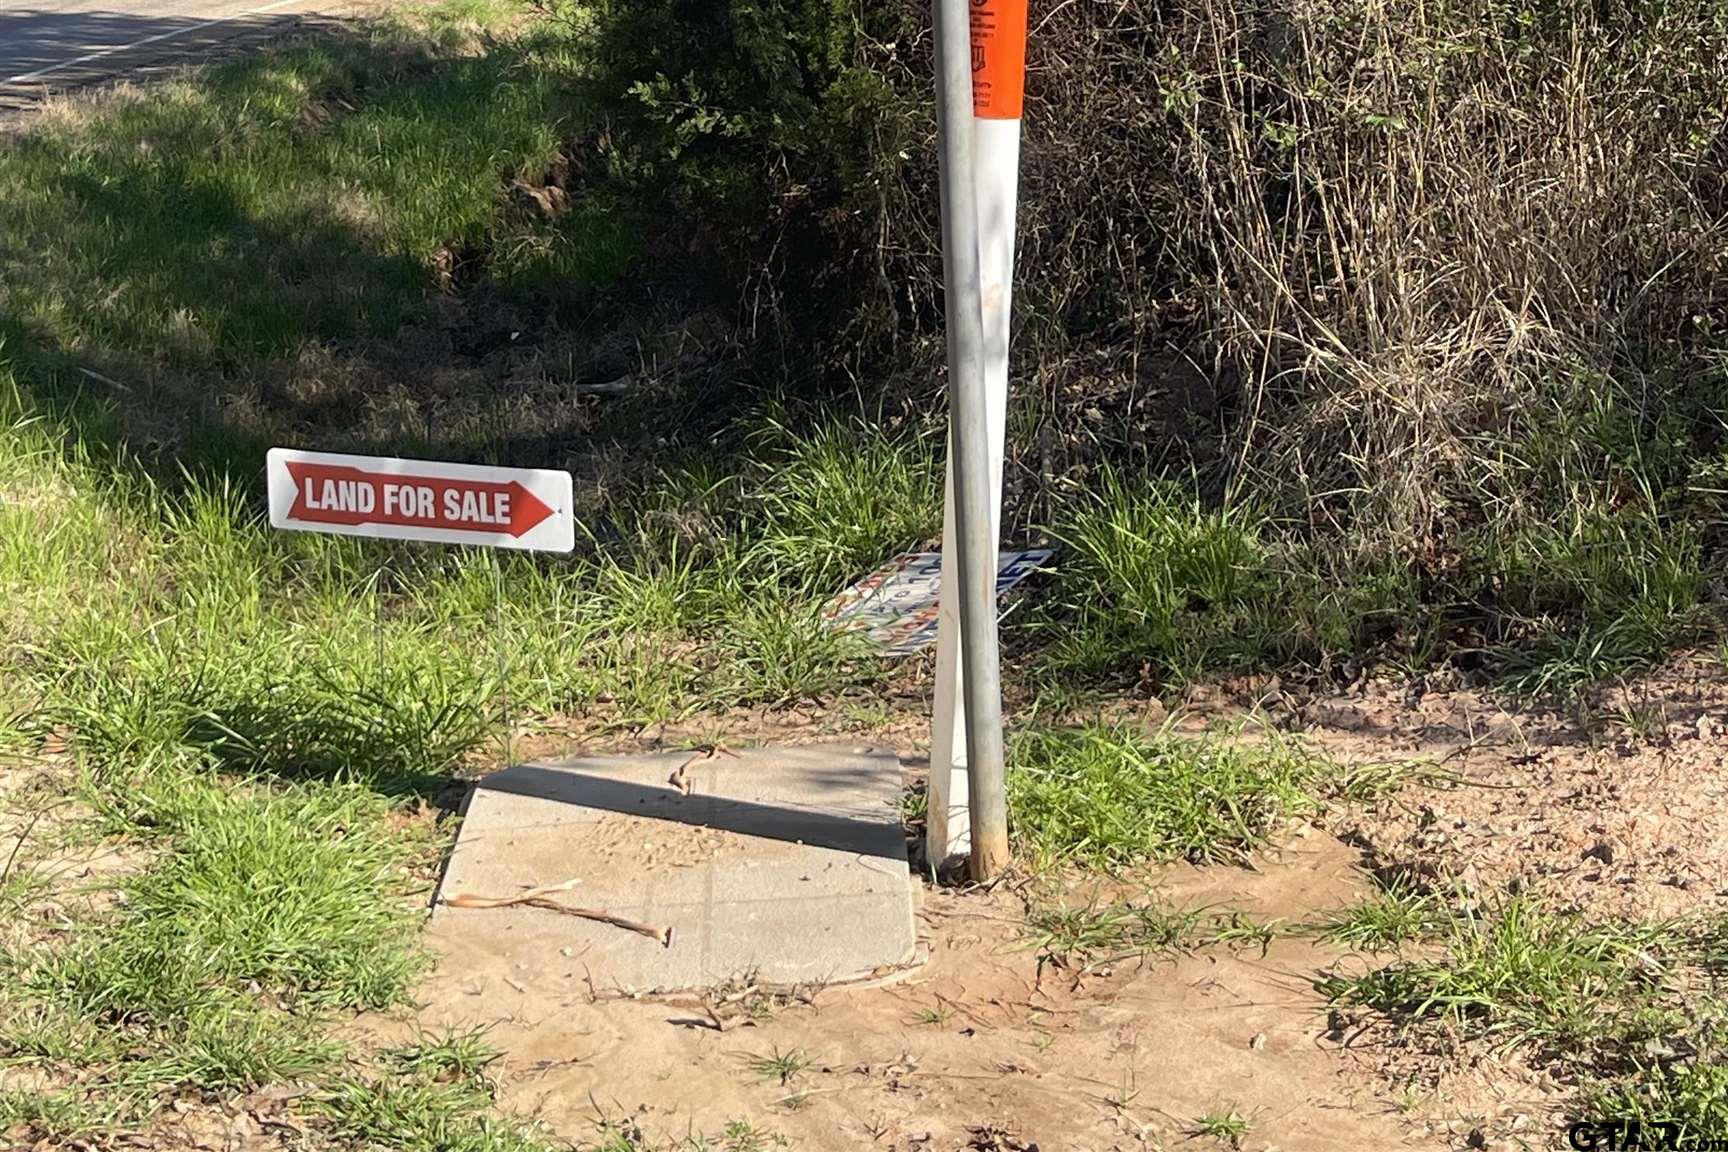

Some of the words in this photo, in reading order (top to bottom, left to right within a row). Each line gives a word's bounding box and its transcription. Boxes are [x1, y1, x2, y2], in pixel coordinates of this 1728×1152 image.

[304, 477, 376, 514] LAND
[383, 483, 436, 519] FOR
[443, 489, 511, 524] SALE
